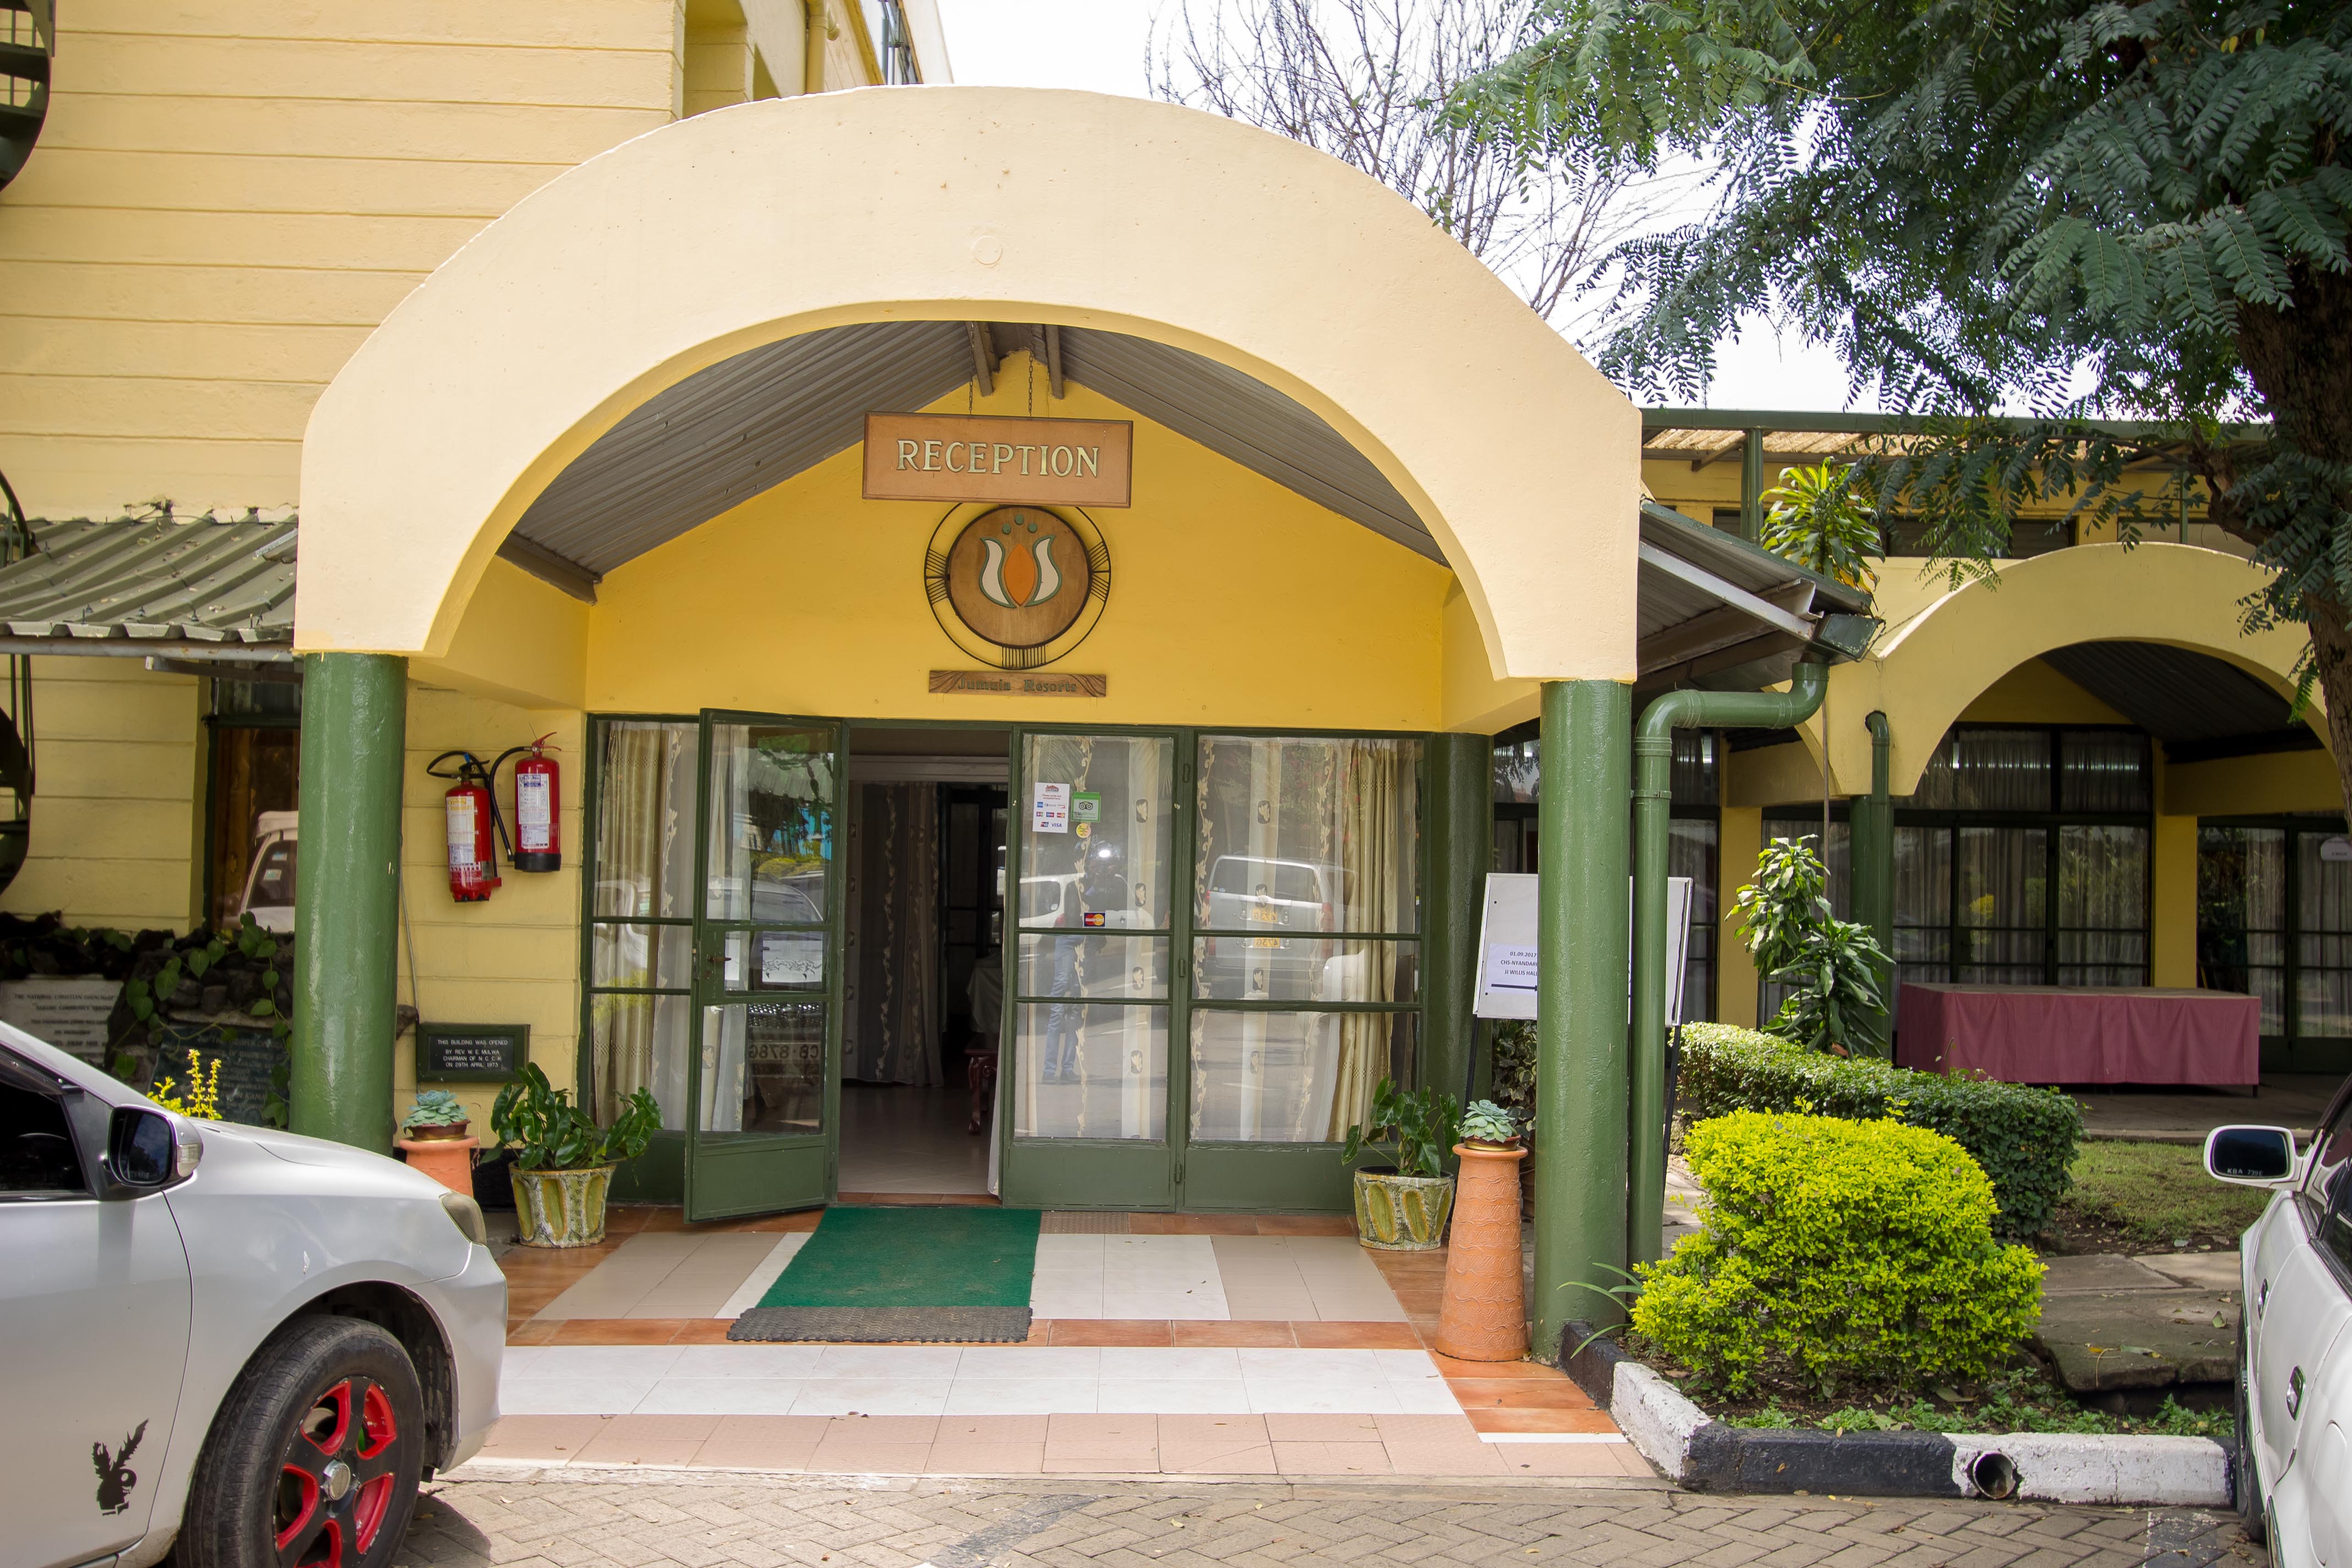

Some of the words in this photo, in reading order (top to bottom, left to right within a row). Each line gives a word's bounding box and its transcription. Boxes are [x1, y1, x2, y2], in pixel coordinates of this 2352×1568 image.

[896, 439, 1099, 478] RECEPTION
[957, 678, 1011, 691] Jumuia
[1023, 679, 1077, 693] Resorts
